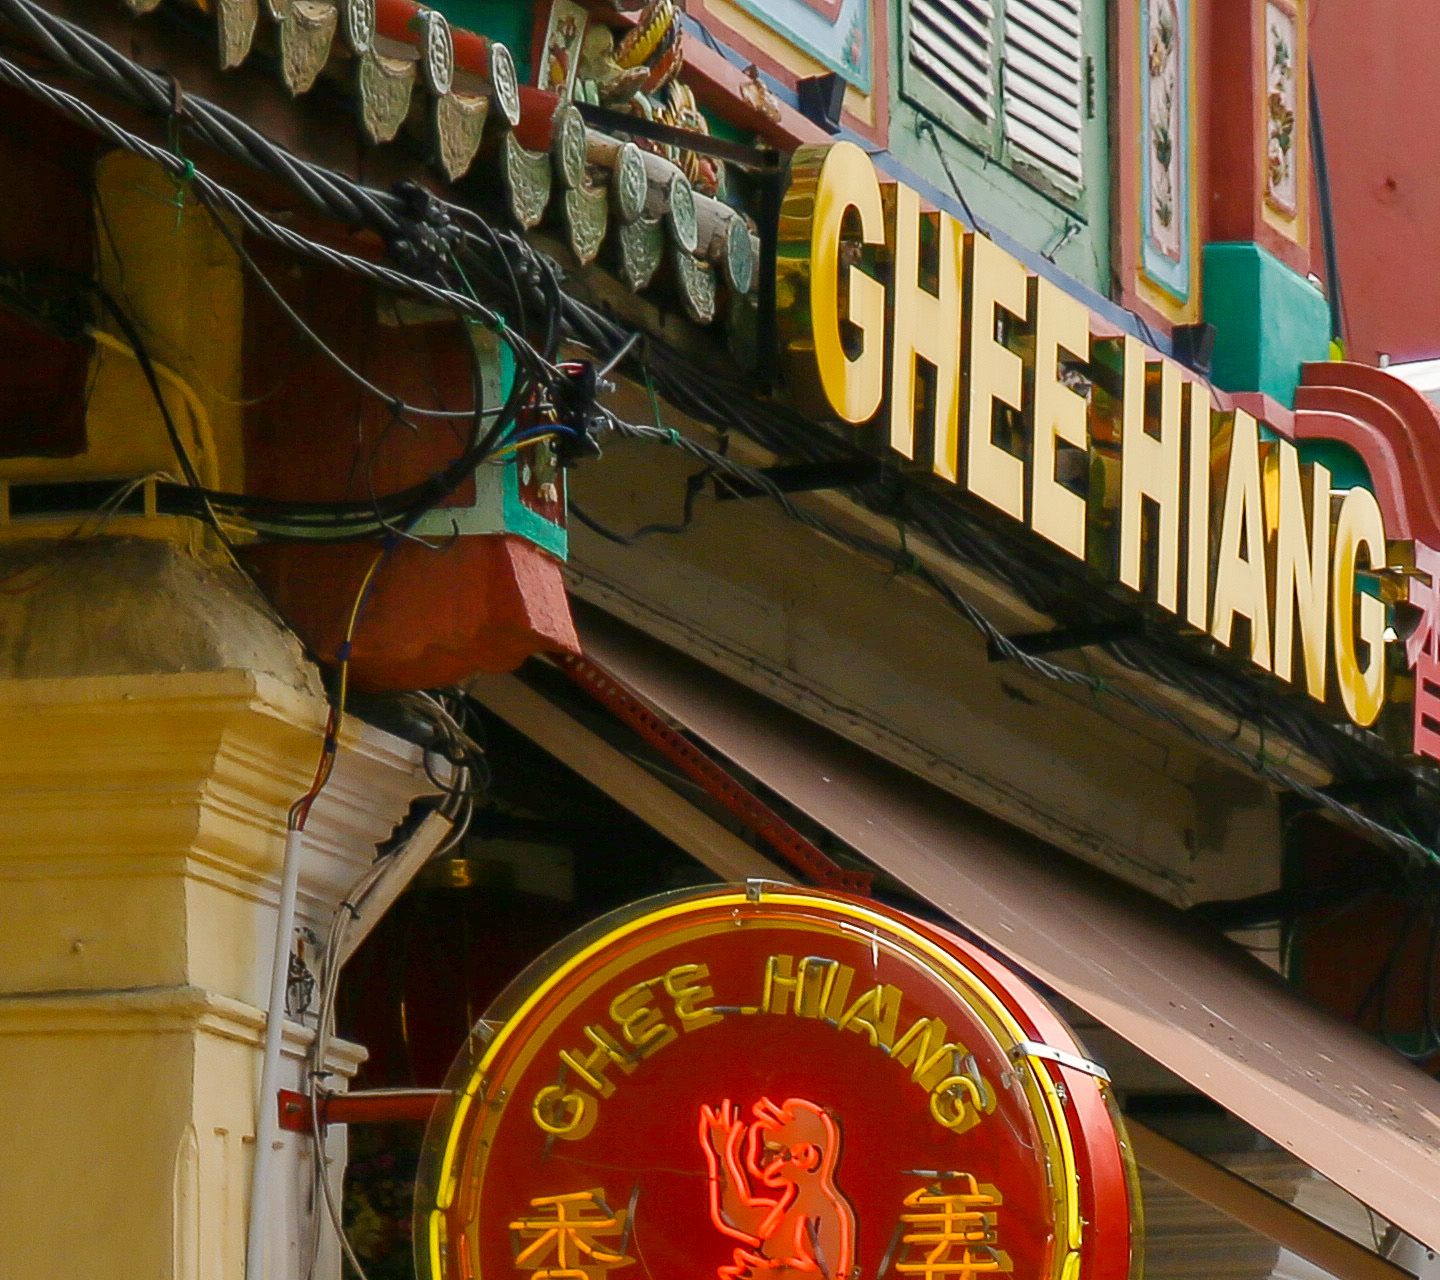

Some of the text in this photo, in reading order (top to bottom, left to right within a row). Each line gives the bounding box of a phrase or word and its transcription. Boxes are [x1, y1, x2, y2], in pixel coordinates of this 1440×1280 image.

[808, 140, 1389, 729] GHEE HIANG
[531, 953, 998, 1140] GHEE HIANG
